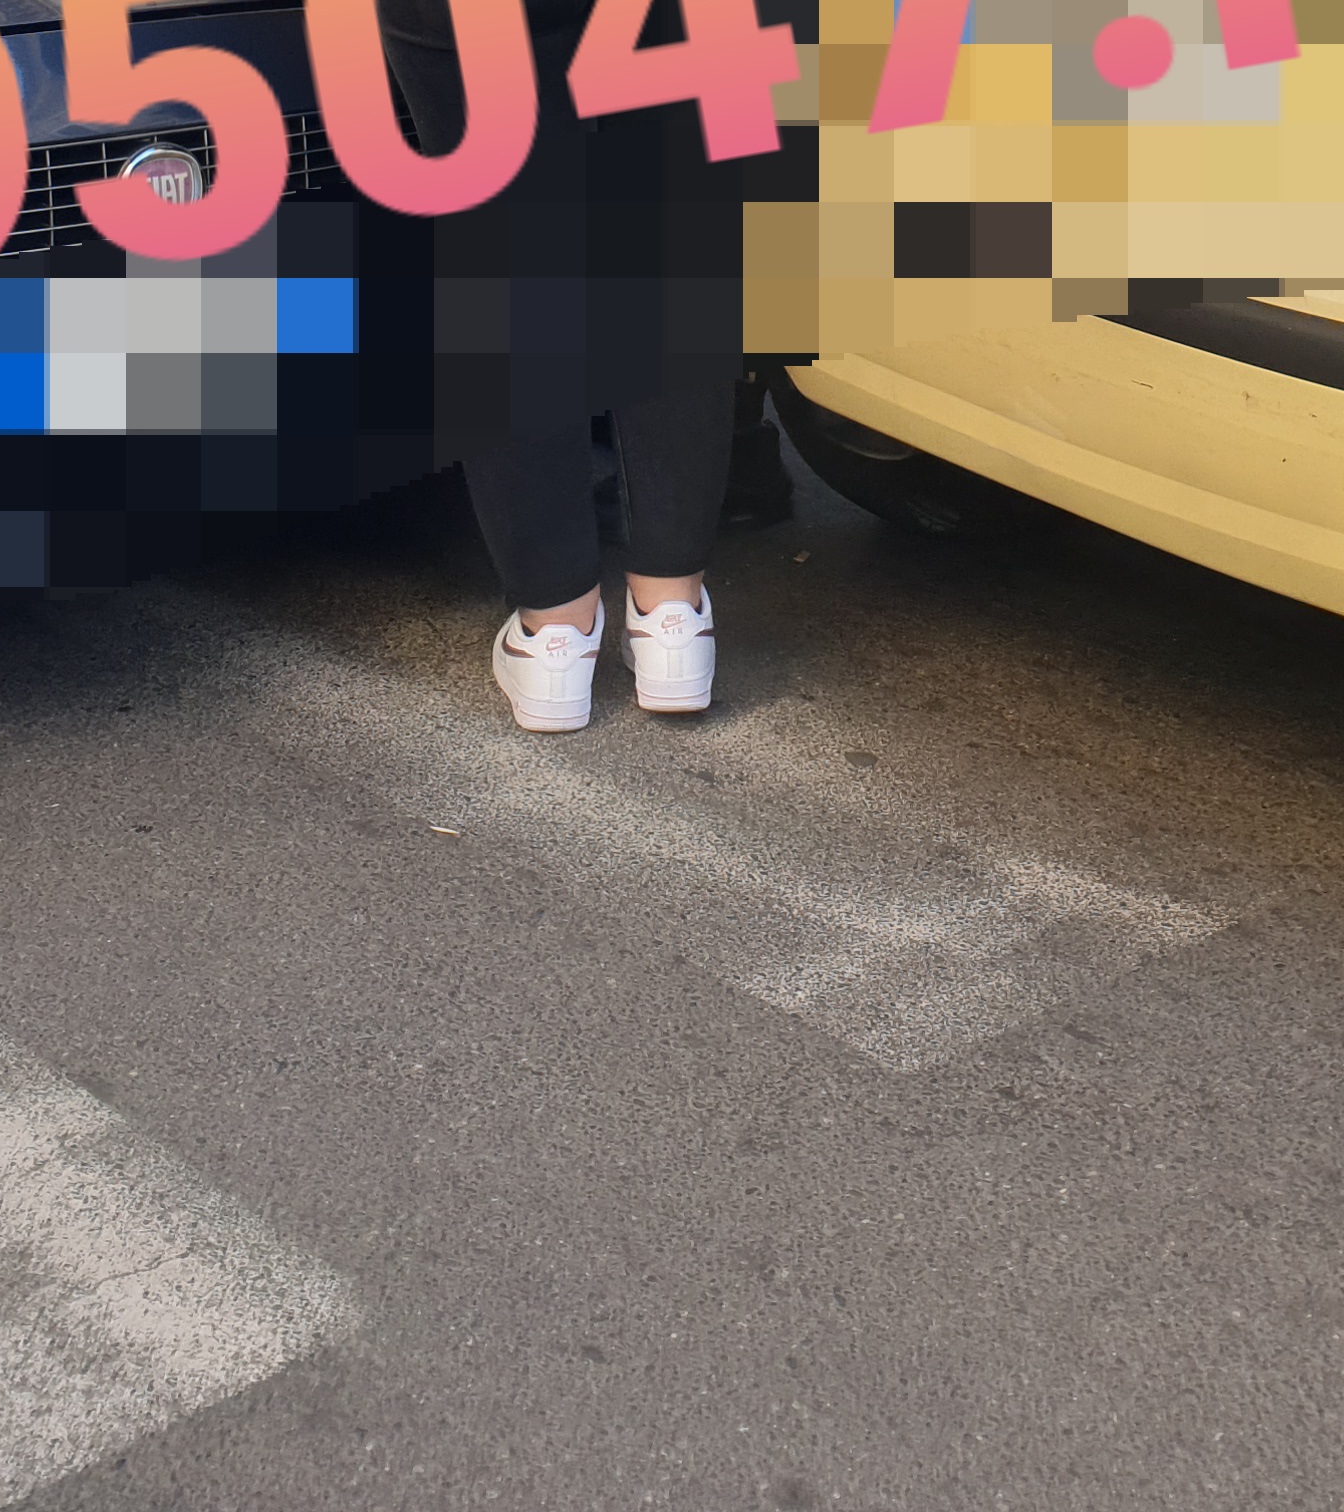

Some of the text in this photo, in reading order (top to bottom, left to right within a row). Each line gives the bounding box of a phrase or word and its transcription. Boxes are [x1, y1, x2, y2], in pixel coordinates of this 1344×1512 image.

[145, 171, 188, 204] IAT
[664, 627, 684, 635] AIR
[547, 649, 568, 658] AIR
